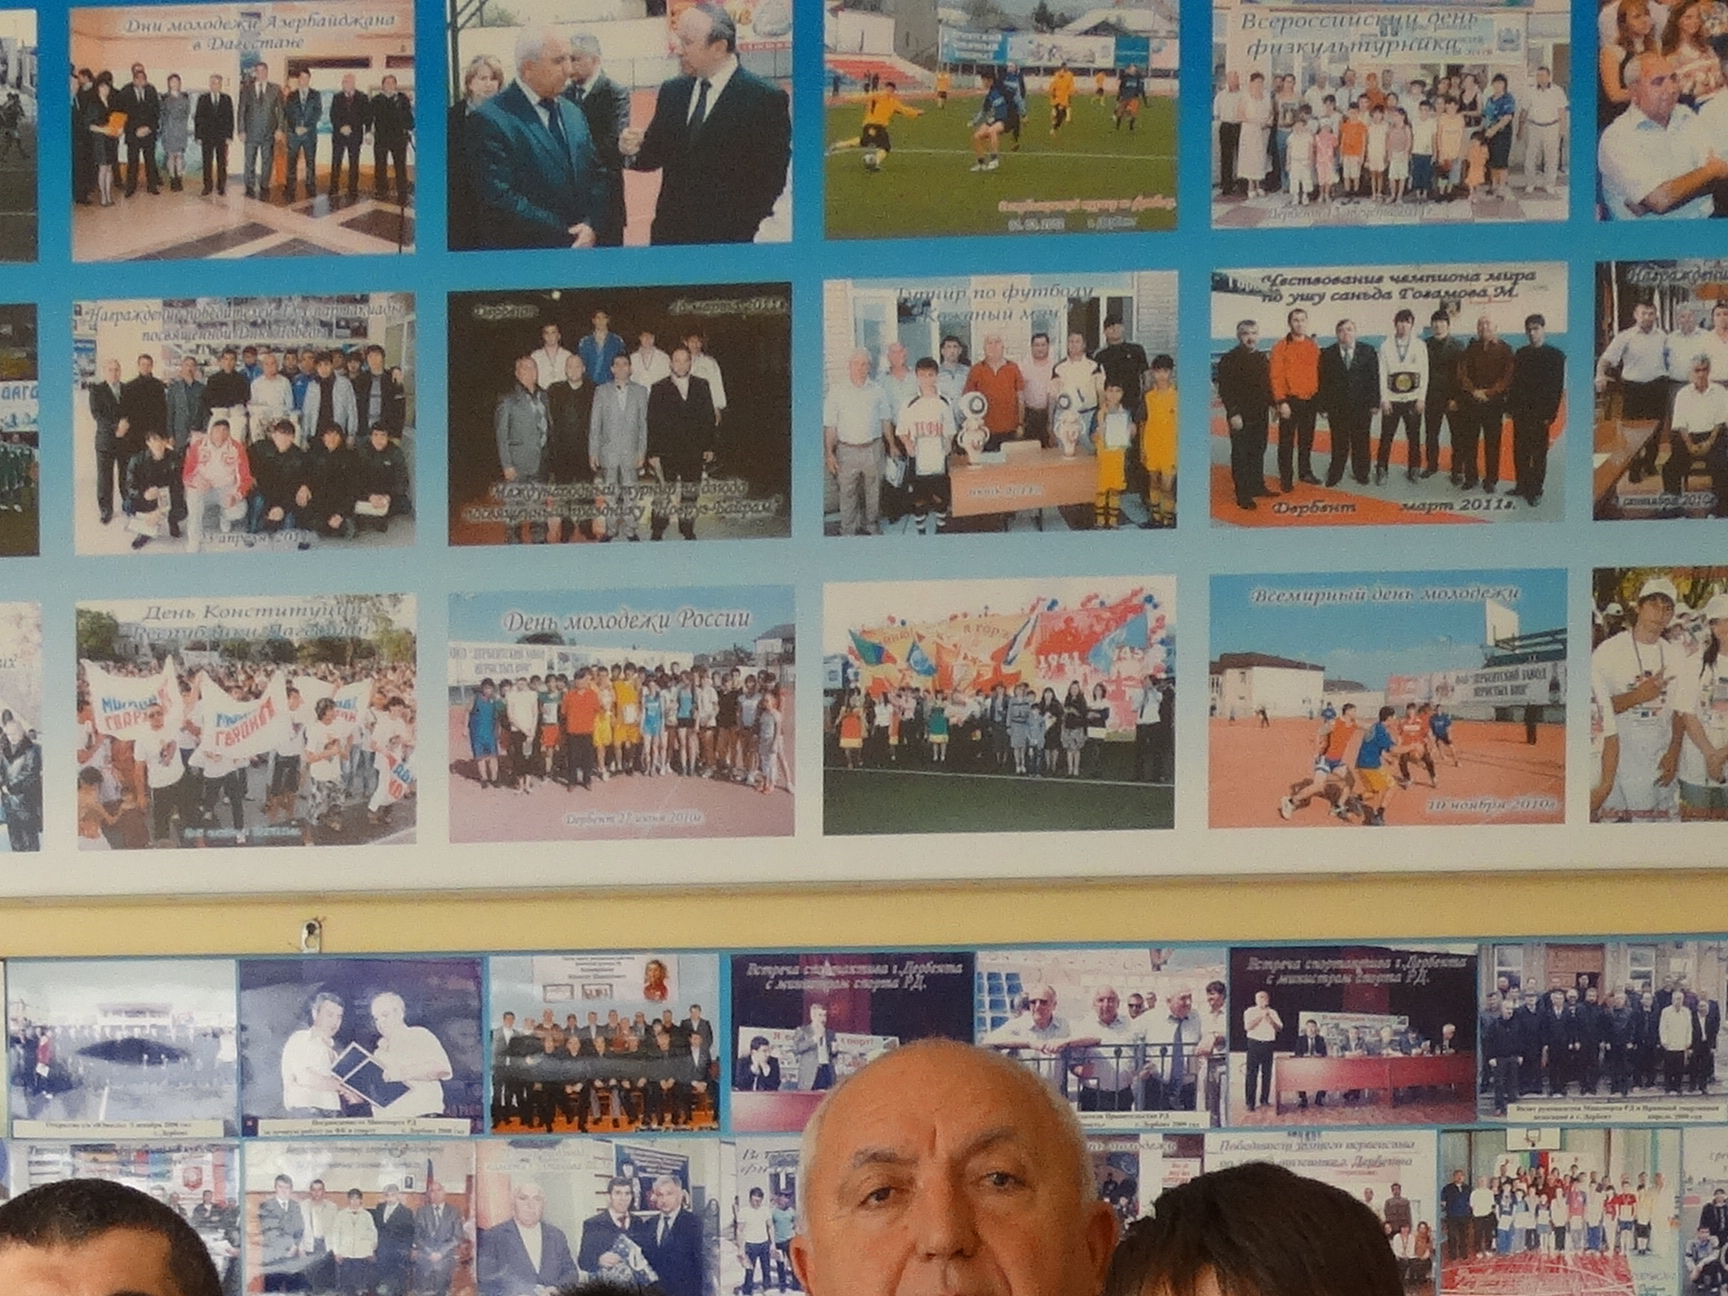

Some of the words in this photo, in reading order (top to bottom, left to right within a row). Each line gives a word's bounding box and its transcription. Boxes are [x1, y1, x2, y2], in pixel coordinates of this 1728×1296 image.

[126, 19, 163, 33] Дни
[167, 17, 260, 33] молодежи
[1241, 11, 1420, 31] Всероссийский
[1426, 9, 1479, 26] день
[207, 37, 305, 51] Дагестане
[1246, 36, 1460, 60] физкультурника
[1389, 272, 1481, 285] чемпиона
[1484, 270, 1537, 289] мира
[1261, 292, 1283, 304] по
[1286, 292, 1326, 306] ушу
[1253, 588, 1368, 606] Всемирный
[1371, 587, 1414, 601] день
[1420, 585, 1520, 602] молодежи
[144, 605, 196, 622] День
[505, 610, 559, 633] День
[563, 608, 672, 634] молодежи
[677, 608, 752, 630] России
